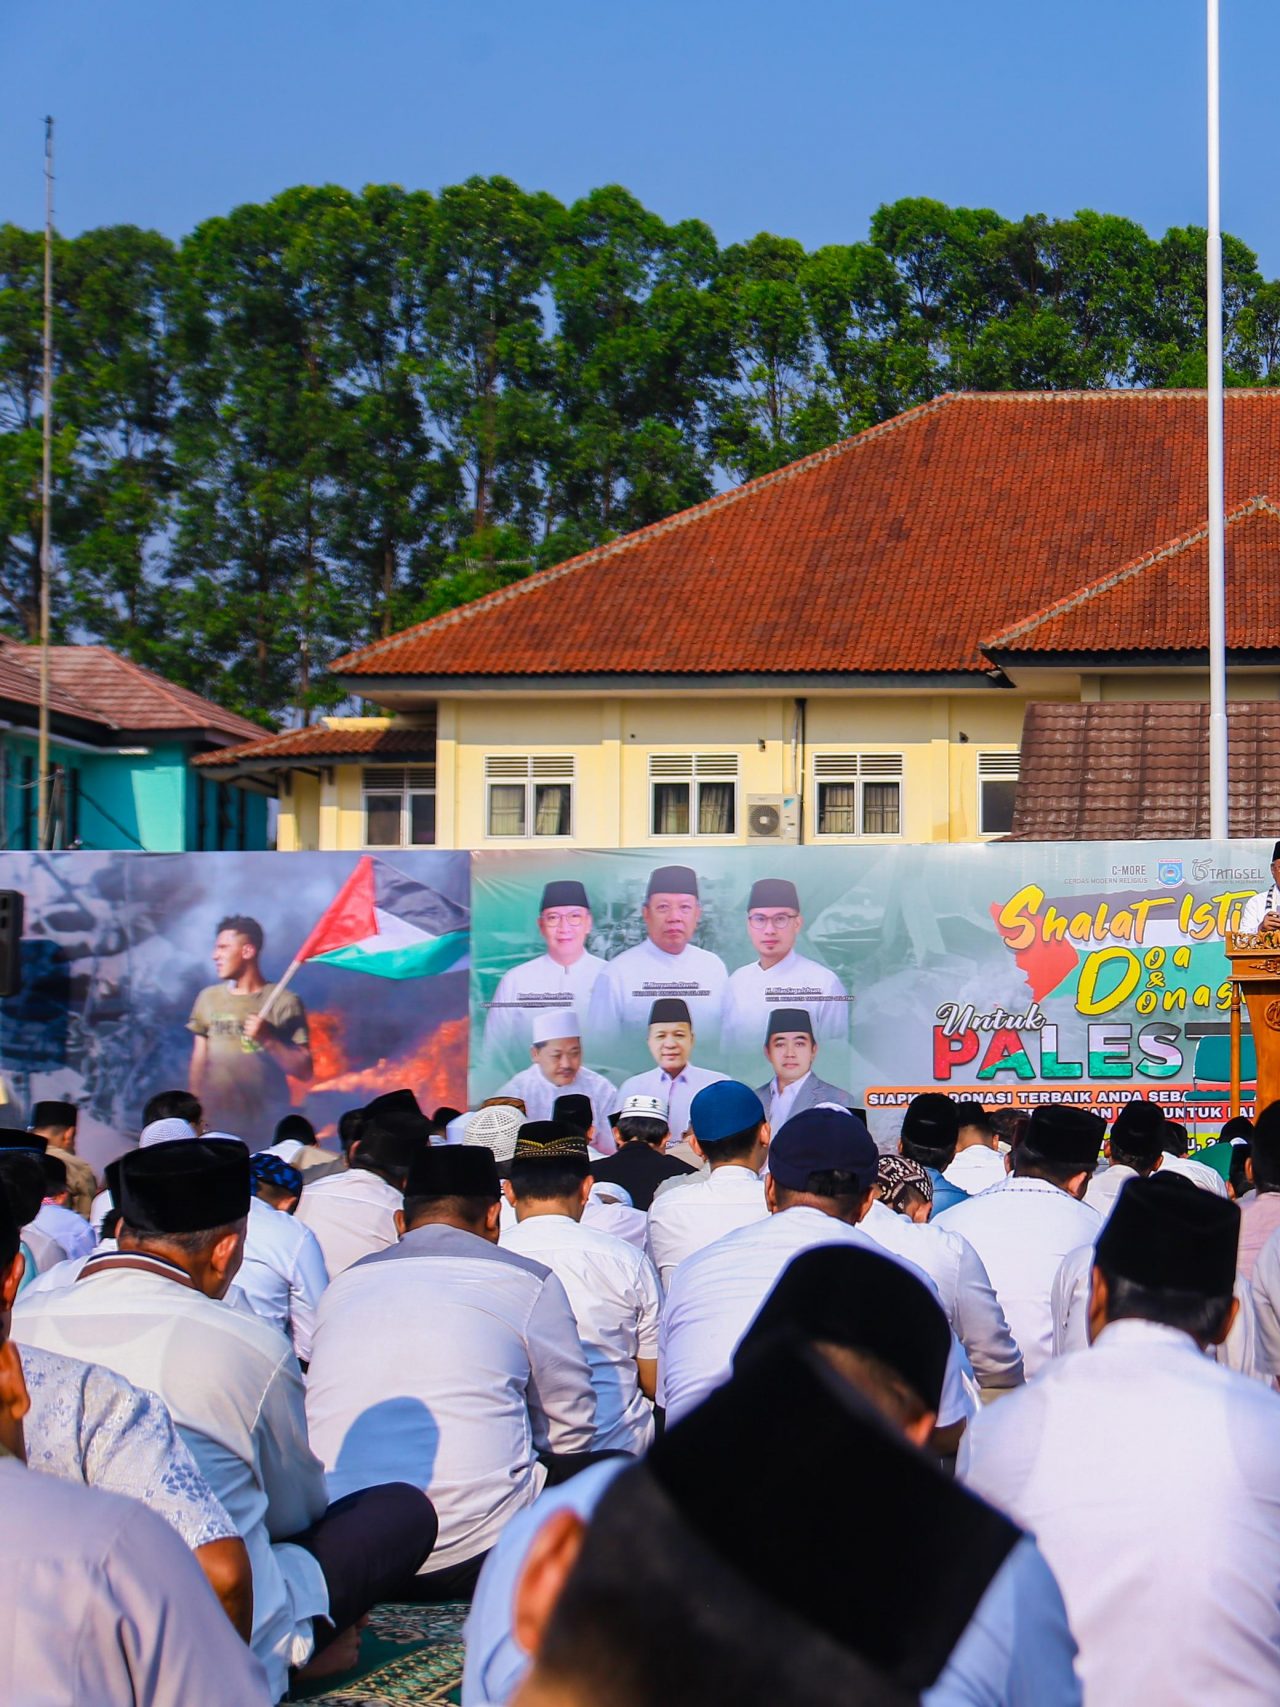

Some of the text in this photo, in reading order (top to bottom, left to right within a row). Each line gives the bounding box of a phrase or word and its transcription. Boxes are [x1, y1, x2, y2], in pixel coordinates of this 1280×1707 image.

[1111, 865, 1147, 876] C-MORE
[999, 883, 1258, 950] Shalat Isti
[935, 1001, 1047, 1038] Untuk
[1017, 1090, 1092, 1104] TERBAIK
[1096, 1089, 1143, 1103] ANDA
[1162, 1106, 1223, 1119] UNTUK
